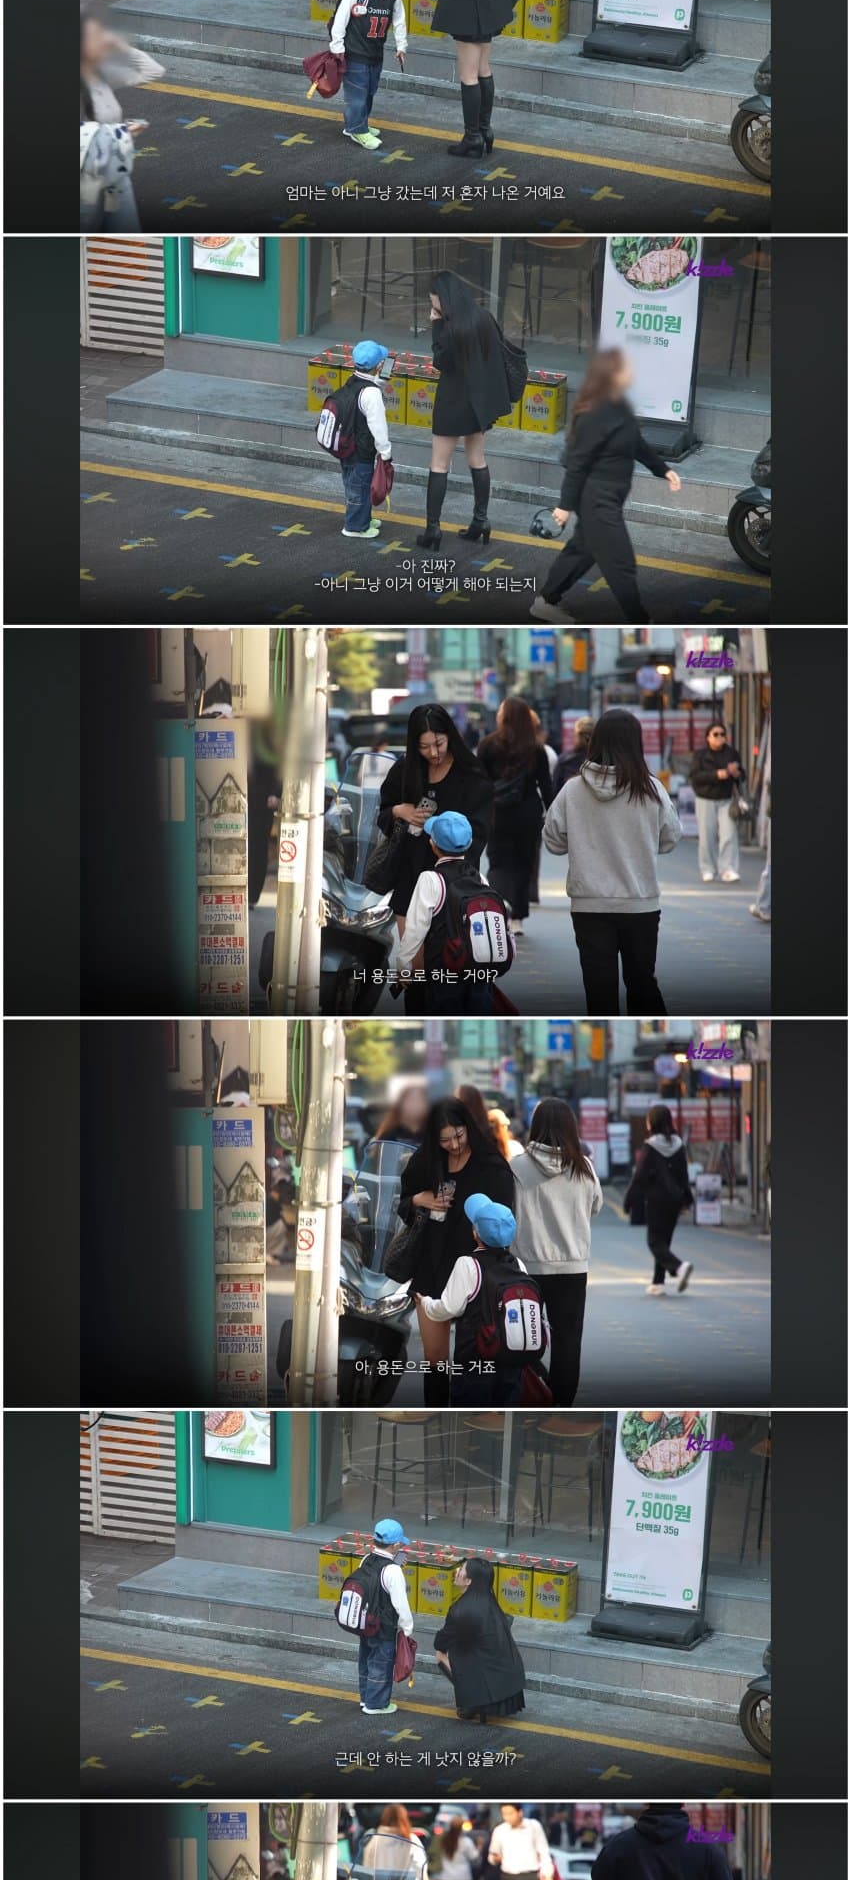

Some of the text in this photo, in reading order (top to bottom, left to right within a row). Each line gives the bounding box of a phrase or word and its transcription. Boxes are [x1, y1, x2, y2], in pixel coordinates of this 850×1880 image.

[367, 16, 389, 38] 11
[615, 310, 681, 333] 7,900원
[653, 335, 669, 347] 35g
[494, 916, 502, 959] DONGBUK
[529, 1304, 537, 1346] DONGBUK
[625, 1499, 692, 1523] 7,900원
[636, 1521, 679, 1536] 단백질 35g
